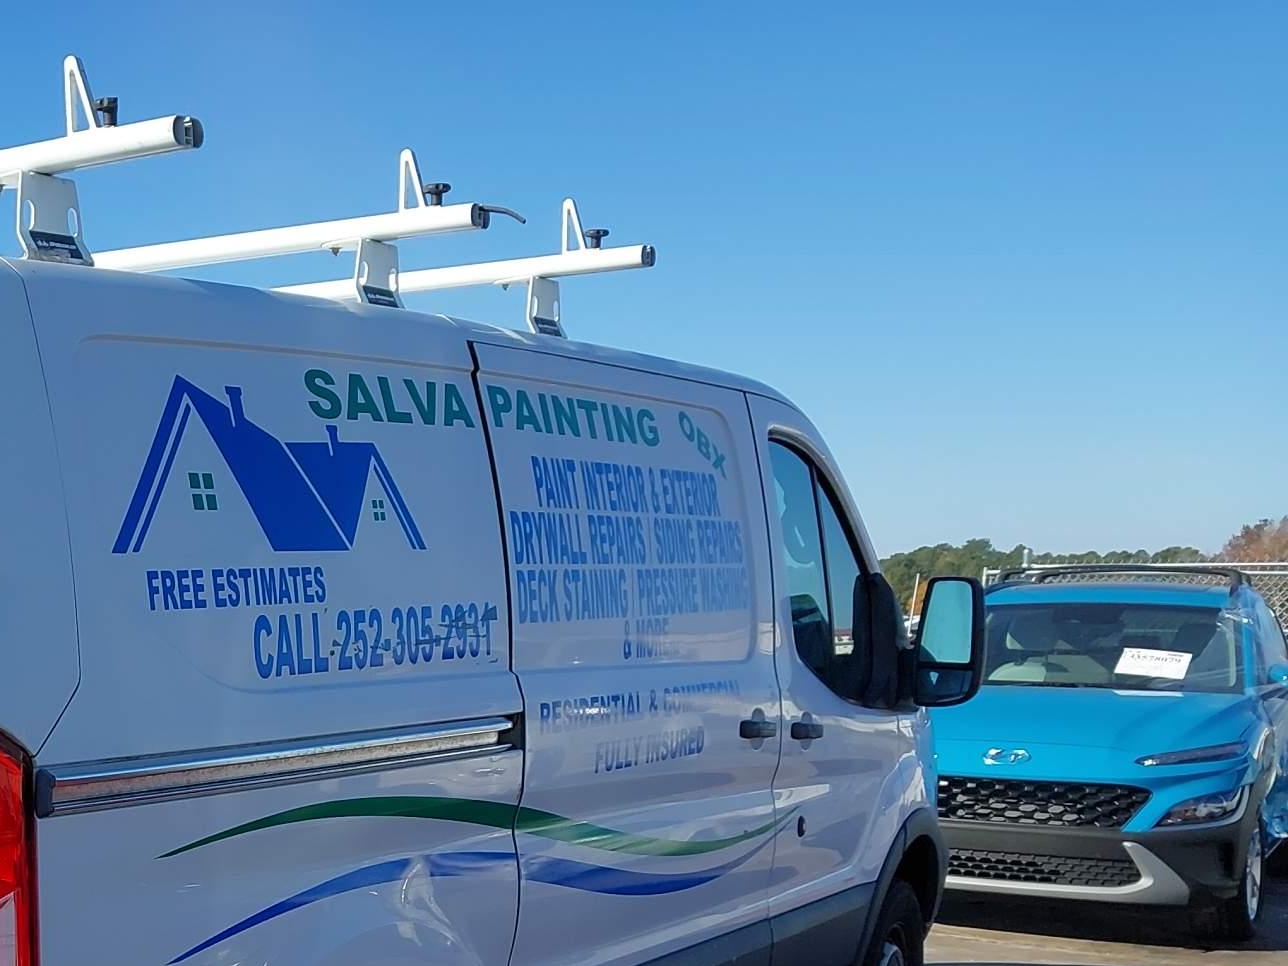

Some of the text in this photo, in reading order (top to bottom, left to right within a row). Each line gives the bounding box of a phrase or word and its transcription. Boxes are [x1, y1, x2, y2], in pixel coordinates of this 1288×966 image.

[303, 368, 728, 480] SALVA PAINTING OBX
[531, 456, 722, 517] PAINT INTERIOR & EXTERIOR
[510, 510, 587, 565] DRYWALL
[588, 515, 647, 565] REPAIRS
[654, 519, 695, 565] SIDING
[697, 520, 744, 565] REPAIRS
[146, 566, 327, 611] FREE ESTIMATES
[516, 569, 560, 624] DECK
[562, 568, 628, 619] STAINING
[637, 568, 698, 617] PRESSURE
[253, 613, 329, 680] CALL
[623, 620, 632, 660] &
[594, 726, 705, 774] FULLY INSURED
